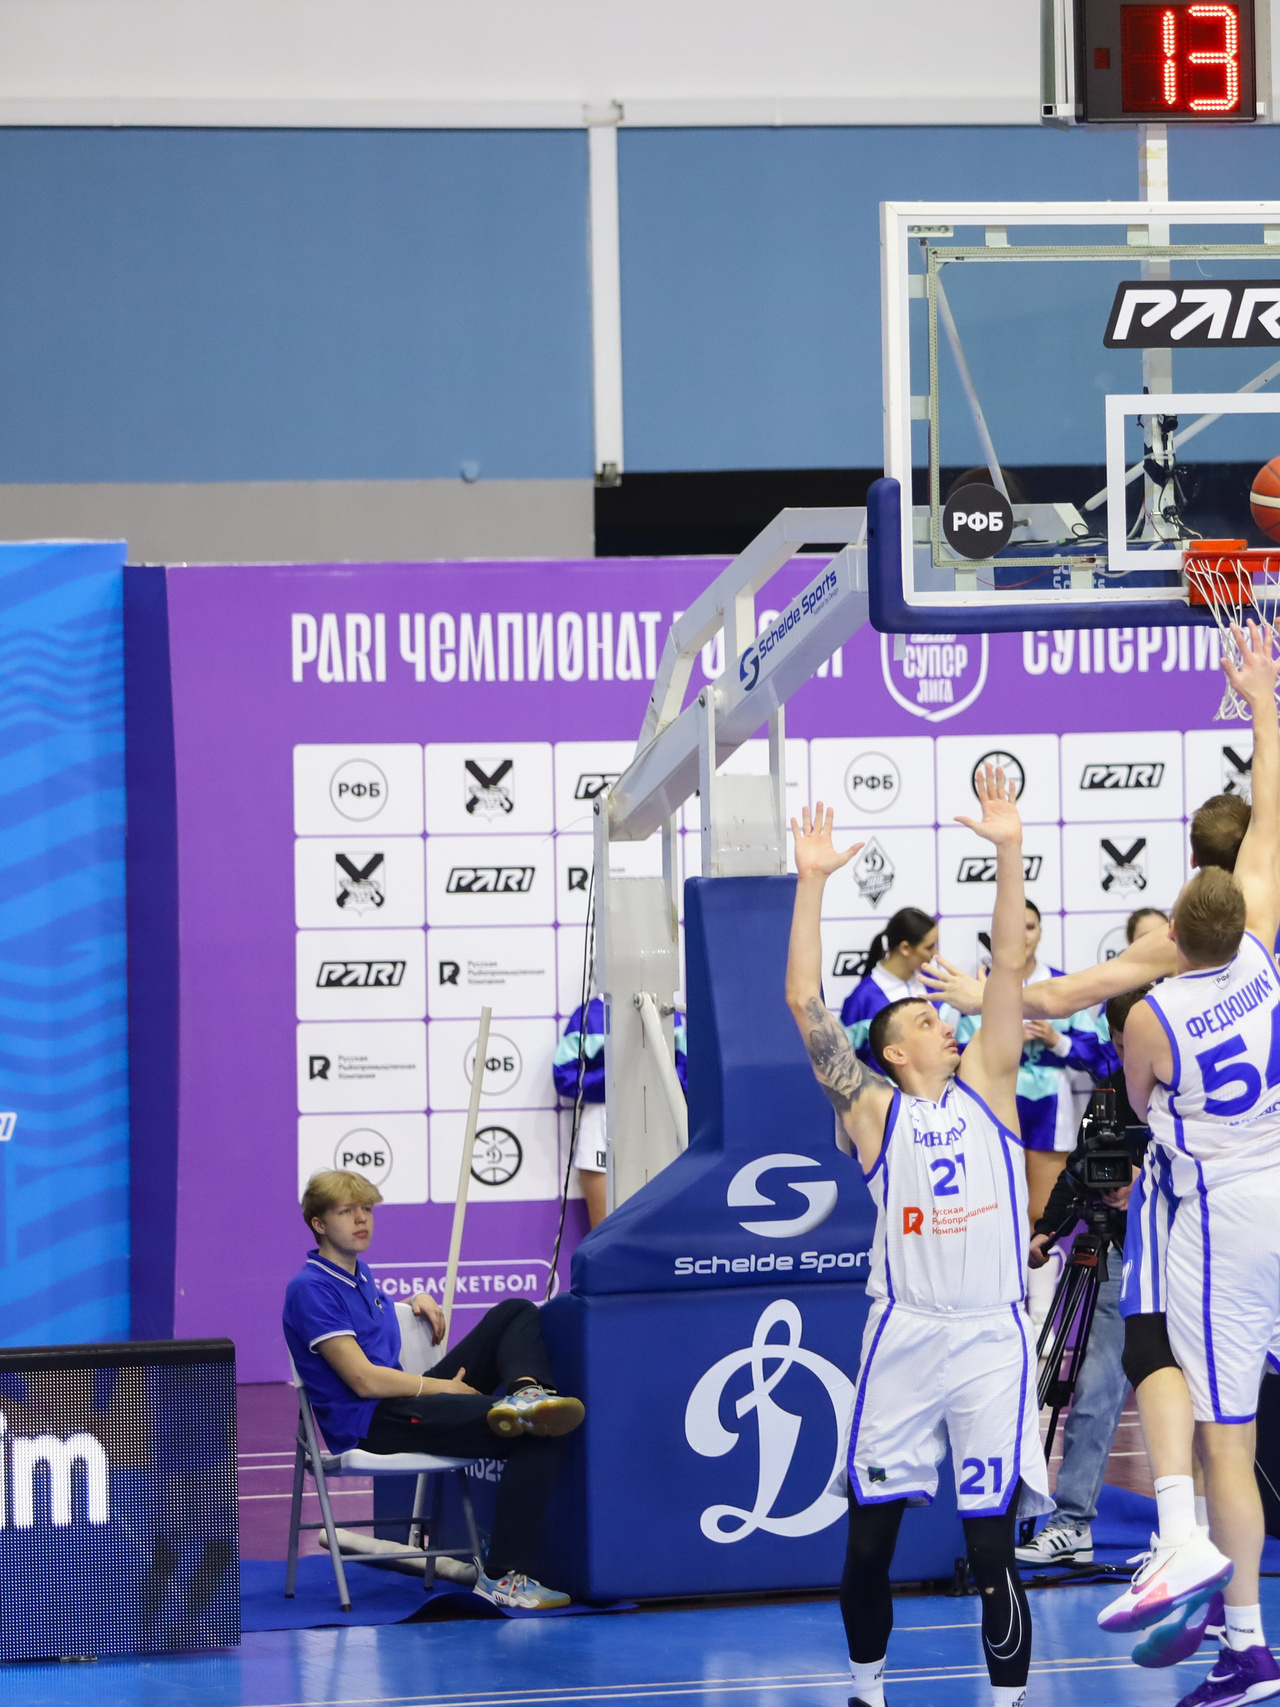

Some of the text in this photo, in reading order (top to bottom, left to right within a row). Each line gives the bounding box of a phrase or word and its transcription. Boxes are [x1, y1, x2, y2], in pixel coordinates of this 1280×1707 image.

[1162, 5, 1238, 111] 13
[952, 511, 1004, 532] РФБ
[758, 607, 801, 659] Schelde
[801, 570, 837, 616] Sports
[291, 612, 387, 683] PARI
[1022, 625, 1235, 676] СУПЕРЛИ
[903, 644, 969, 679] СУПЕР
[916, 678, 954, 704] ЛИГА
[852, 774, 894, 791] РФБ
[1082, 765, 1163, 788] PARI
[338, 781, 381, 799] РФБ
[449, 868, 533, 891] PARI
[959, 858, 1041, 881] PI
[319, 962, 404, 987] PARI
[472, 1057, 515, 1072] ФБ
[342, 1150, 385, 1167] РФБ
[932, 1226, 968, 1235] Компан
[674, 1249, 873, 1275] Schelde Sport
[959, 1457, 1003, 1495] 21
